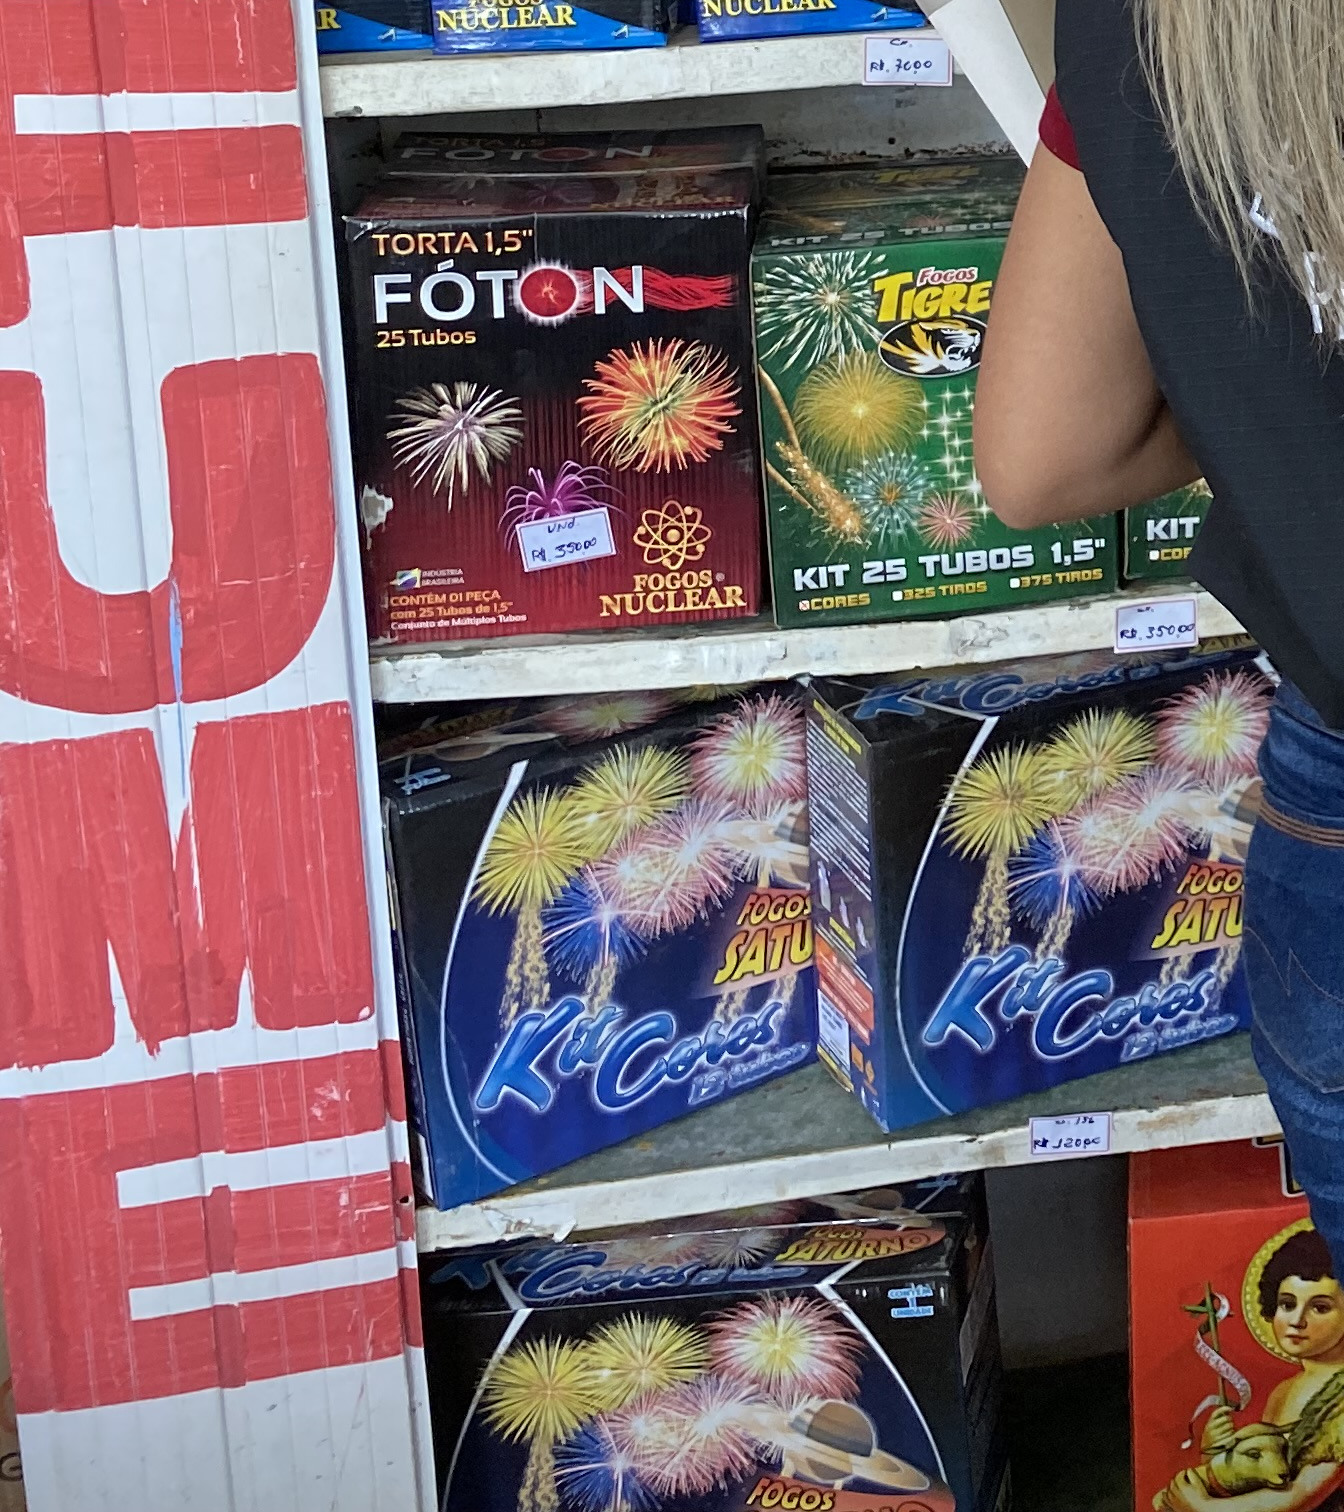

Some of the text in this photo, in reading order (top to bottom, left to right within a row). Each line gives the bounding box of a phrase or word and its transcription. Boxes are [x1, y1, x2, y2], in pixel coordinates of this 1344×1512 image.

[438, 4, 577, 33] NUCLEAR
[372, 229, 533, 256] TORTA 1,5"
[917, 267, 977, 285] FOGOS
[373, 259, 644, 326] FÓTON
[874, 272, 993, 323] TIGRE
[376, 329, 477, 348] 25 Tubos
[793, 538, 1105, 591] KIT 25 TUBOS 1,5"
[634, 570, 713, 591] FOGOS
[390, 589, 500, 608] CONTÉM PEÇA
[600, 585, 746, 617] NUCLEAR
[810, 593, 870, 610] CORES
[923, 944, 1064, 1052] Kit
[476, 995, 616, 1114] Kit
